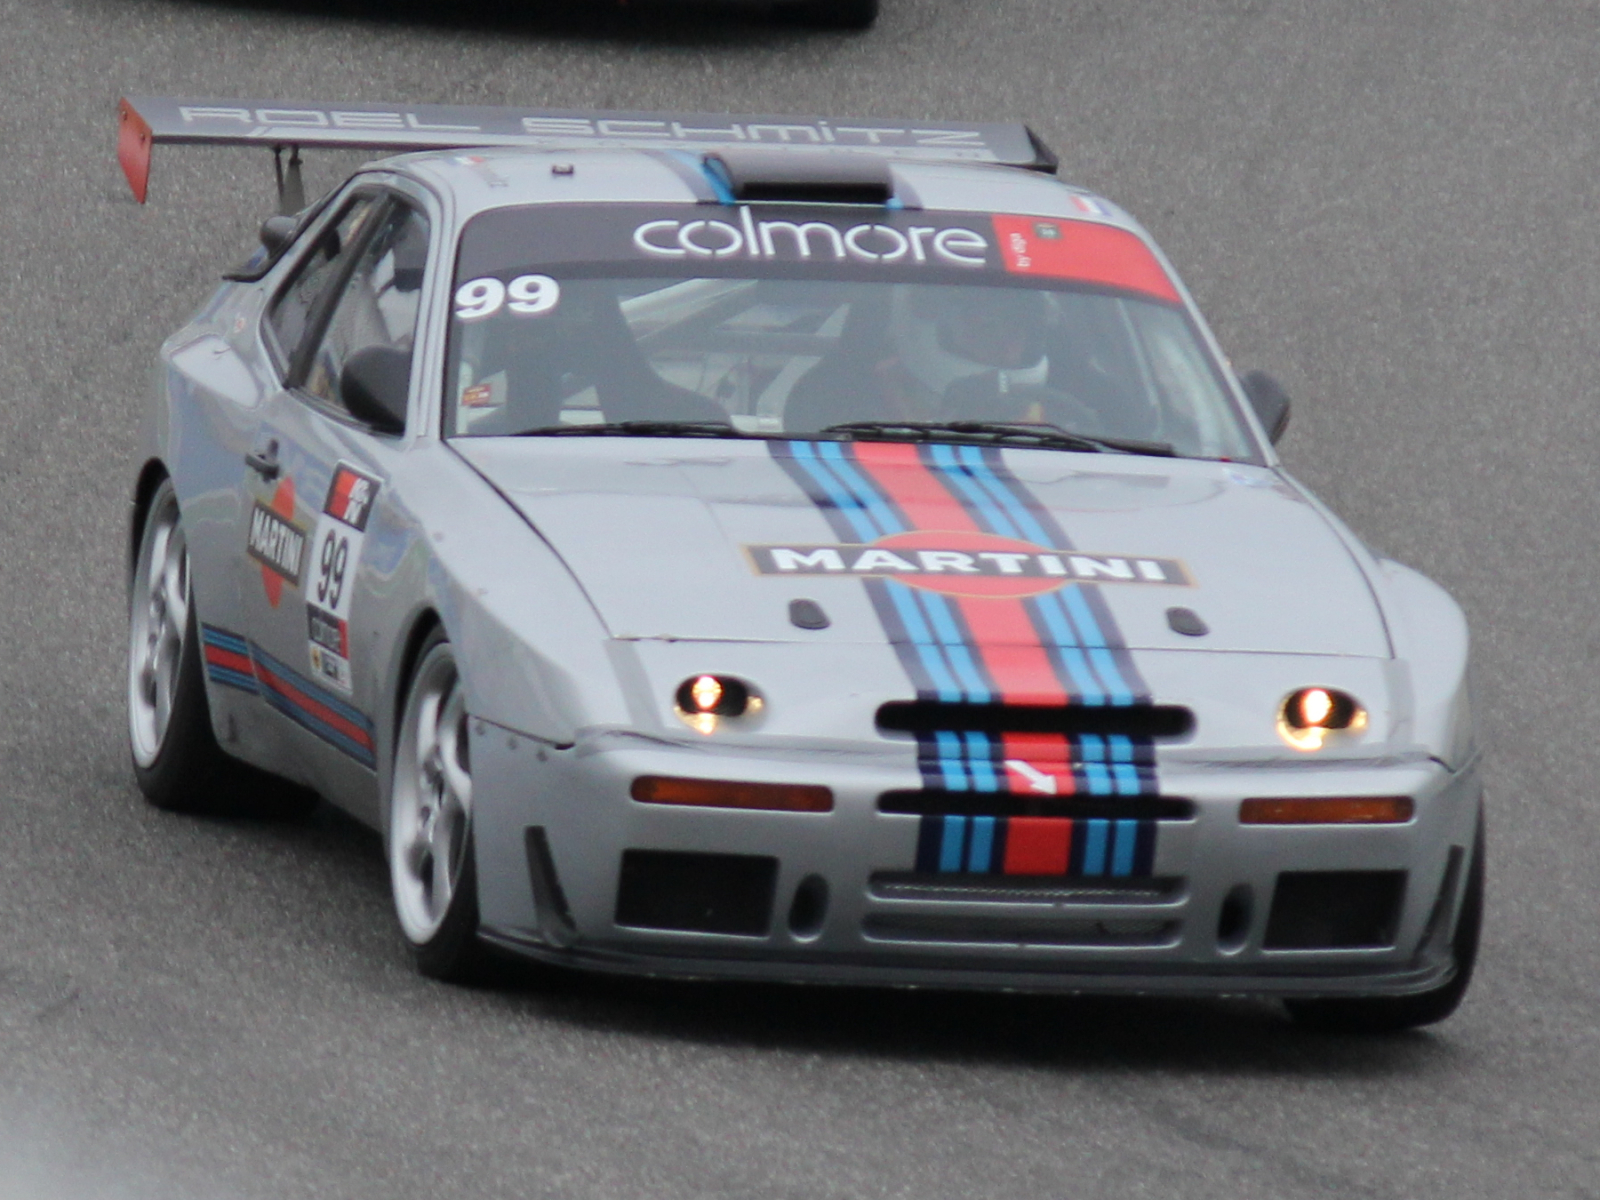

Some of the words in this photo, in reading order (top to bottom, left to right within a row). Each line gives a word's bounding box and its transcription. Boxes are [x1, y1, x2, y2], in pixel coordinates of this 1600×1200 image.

[179, 105, 481, 132] ROEL
[633, 204, 988, 264] colmore
[455, 274, 560, 319] 99
[249, 505, 305, 577] MARTINI
[769, 547, 1168, 582] MARTINI
[317, 527, 349, 610] 99
